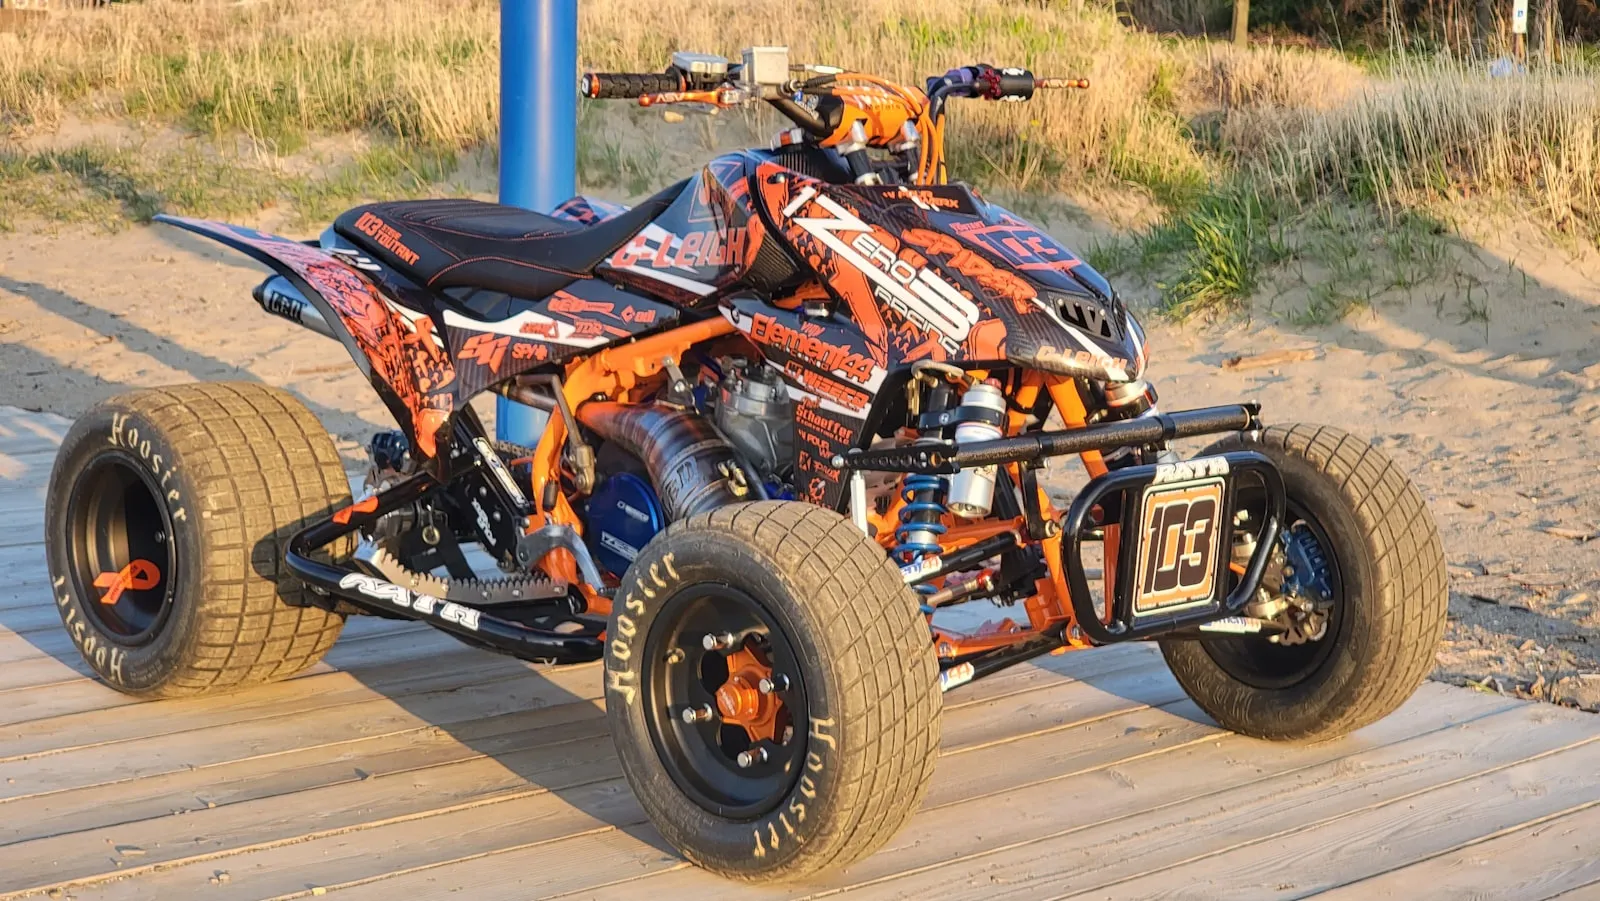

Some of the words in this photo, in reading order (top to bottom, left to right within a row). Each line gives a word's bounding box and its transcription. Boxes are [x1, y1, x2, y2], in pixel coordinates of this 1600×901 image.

[354, 211, 384, 237] 103
[374, 229, 420, 266] TOUTANT
[796, 403, 853, 439] Schaeffer
[108, 412, 187, 522] Hoosier
[1153, 456, 1230, 484] RATH
[1142, 496, 1218, 599] 103
[608, 552, 680, 705] Hoosier
[753, 717, 836, 857] Hoosier
